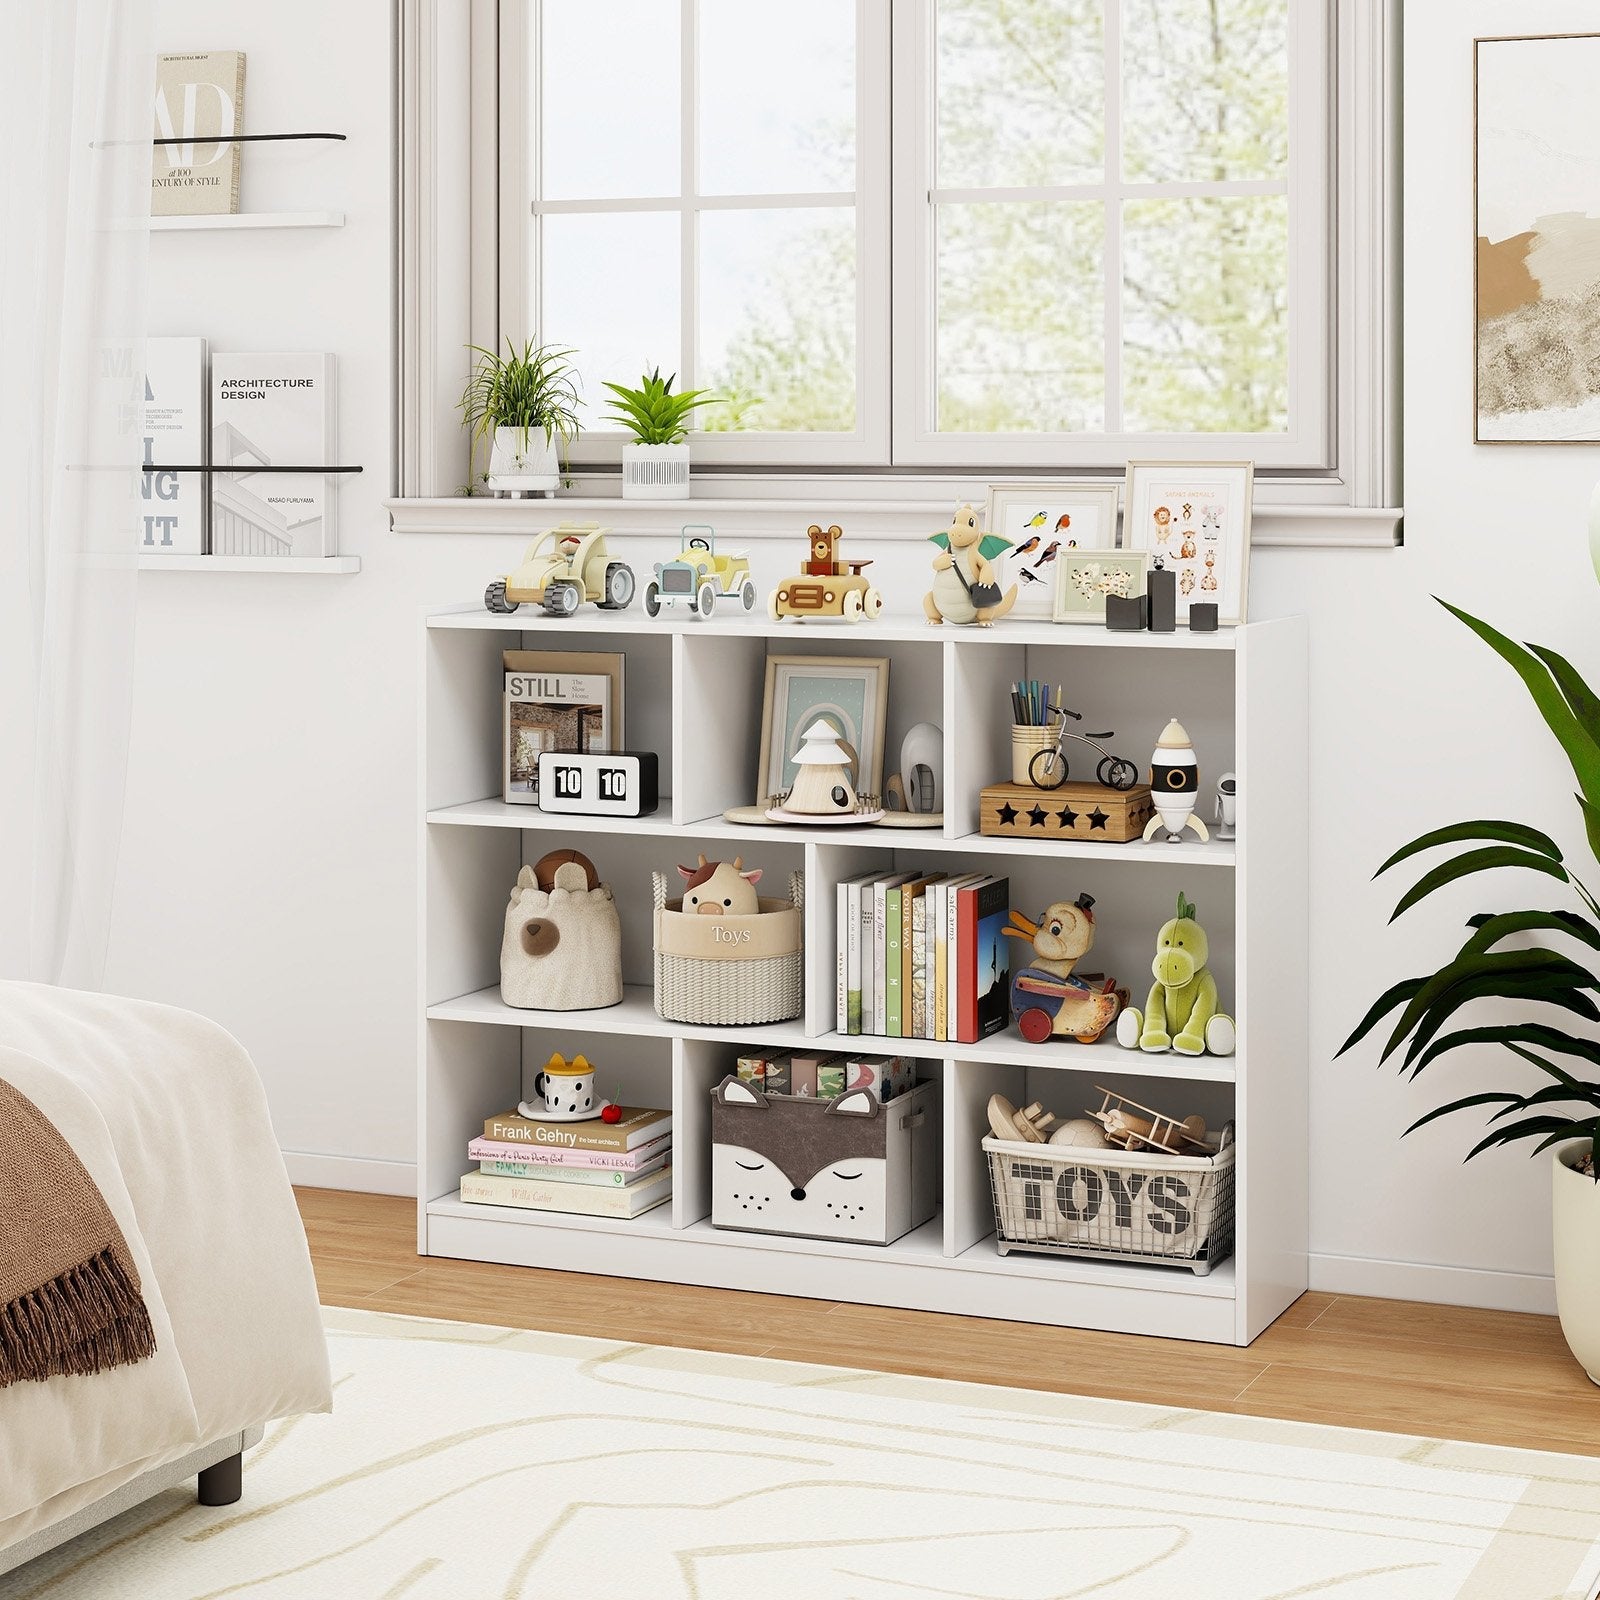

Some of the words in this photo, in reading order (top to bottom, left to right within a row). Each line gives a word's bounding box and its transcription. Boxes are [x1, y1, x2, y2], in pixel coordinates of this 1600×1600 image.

[152, 178, 183, 188] ENTURY
[184, 178, 195, 187] OF
[196, 177, 221, 187] STYLE
[168, 169, 176, 177] at
[177, 169, 191, 177] 100
[220, 379, 314, 388] ARCHITECTURE
[221, 391, 266, 400] DESIGN
[143, 516, 178, 546] IT
[510, 677, 566, 698] STILL
[557, 769, 581, 794] 10
[601, 772, 626, 797] 10
[949, 895, 958, 914] safe
[711, 926, 751, 947] Toys
[889, 904, 898, 1022] HOME
[493, 1123, 532, 1140] Frank
[535, 1127, 577, 1148] Gehry
[598, 1138, 620, 1146] architects
[500, 1150, 508, 1159] of
[513, 1150, 530, 1160] Paris
[550, 1153, 564, 1163] Girl
[589, 1157, 610, 1166] VICKI
[1011, 1162, 1192, 1236] TOYS
